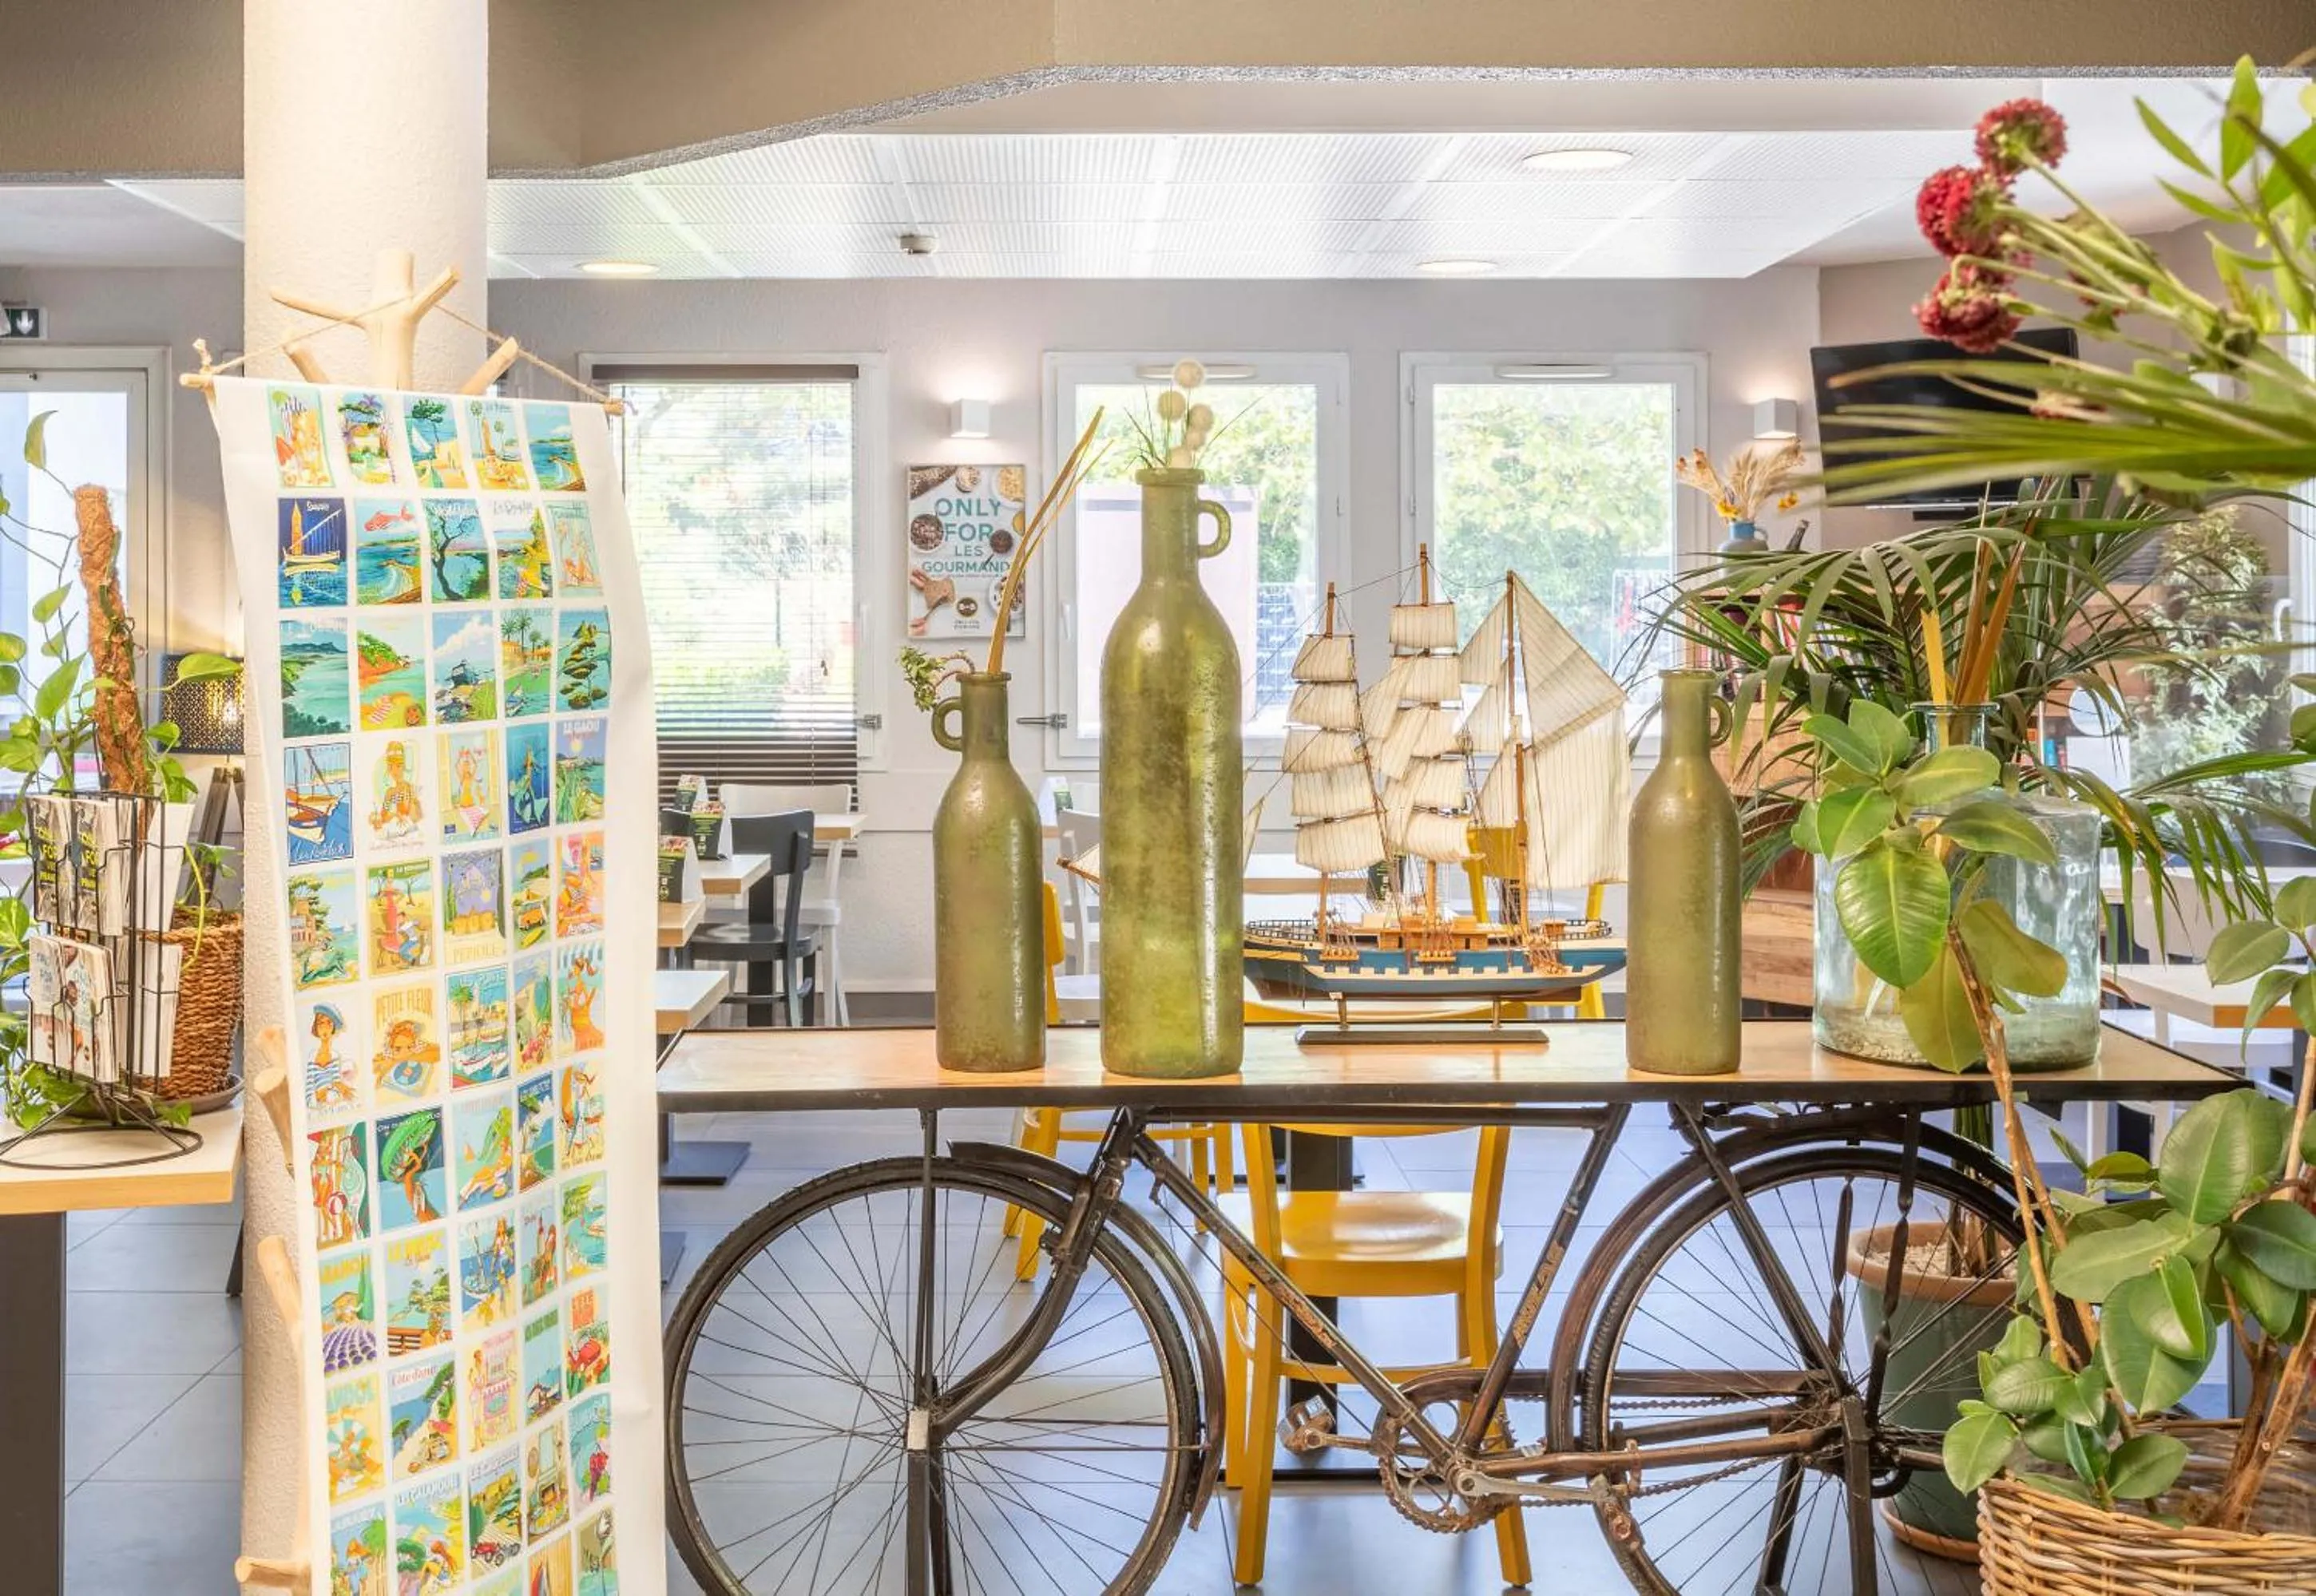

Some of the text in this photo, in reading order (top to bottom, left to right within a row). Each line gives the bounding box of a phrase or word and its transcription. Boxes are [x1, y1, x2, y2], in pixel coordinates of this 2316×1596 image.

[934, 497, 1001, 517] ONLY
[944, 522, 993, 541] FOR
[954, 545, 984, 556] LES
[922, 560, 1011, 573] GOURMAND
[375, 986, 433, 1031] PETITE FLEUR
